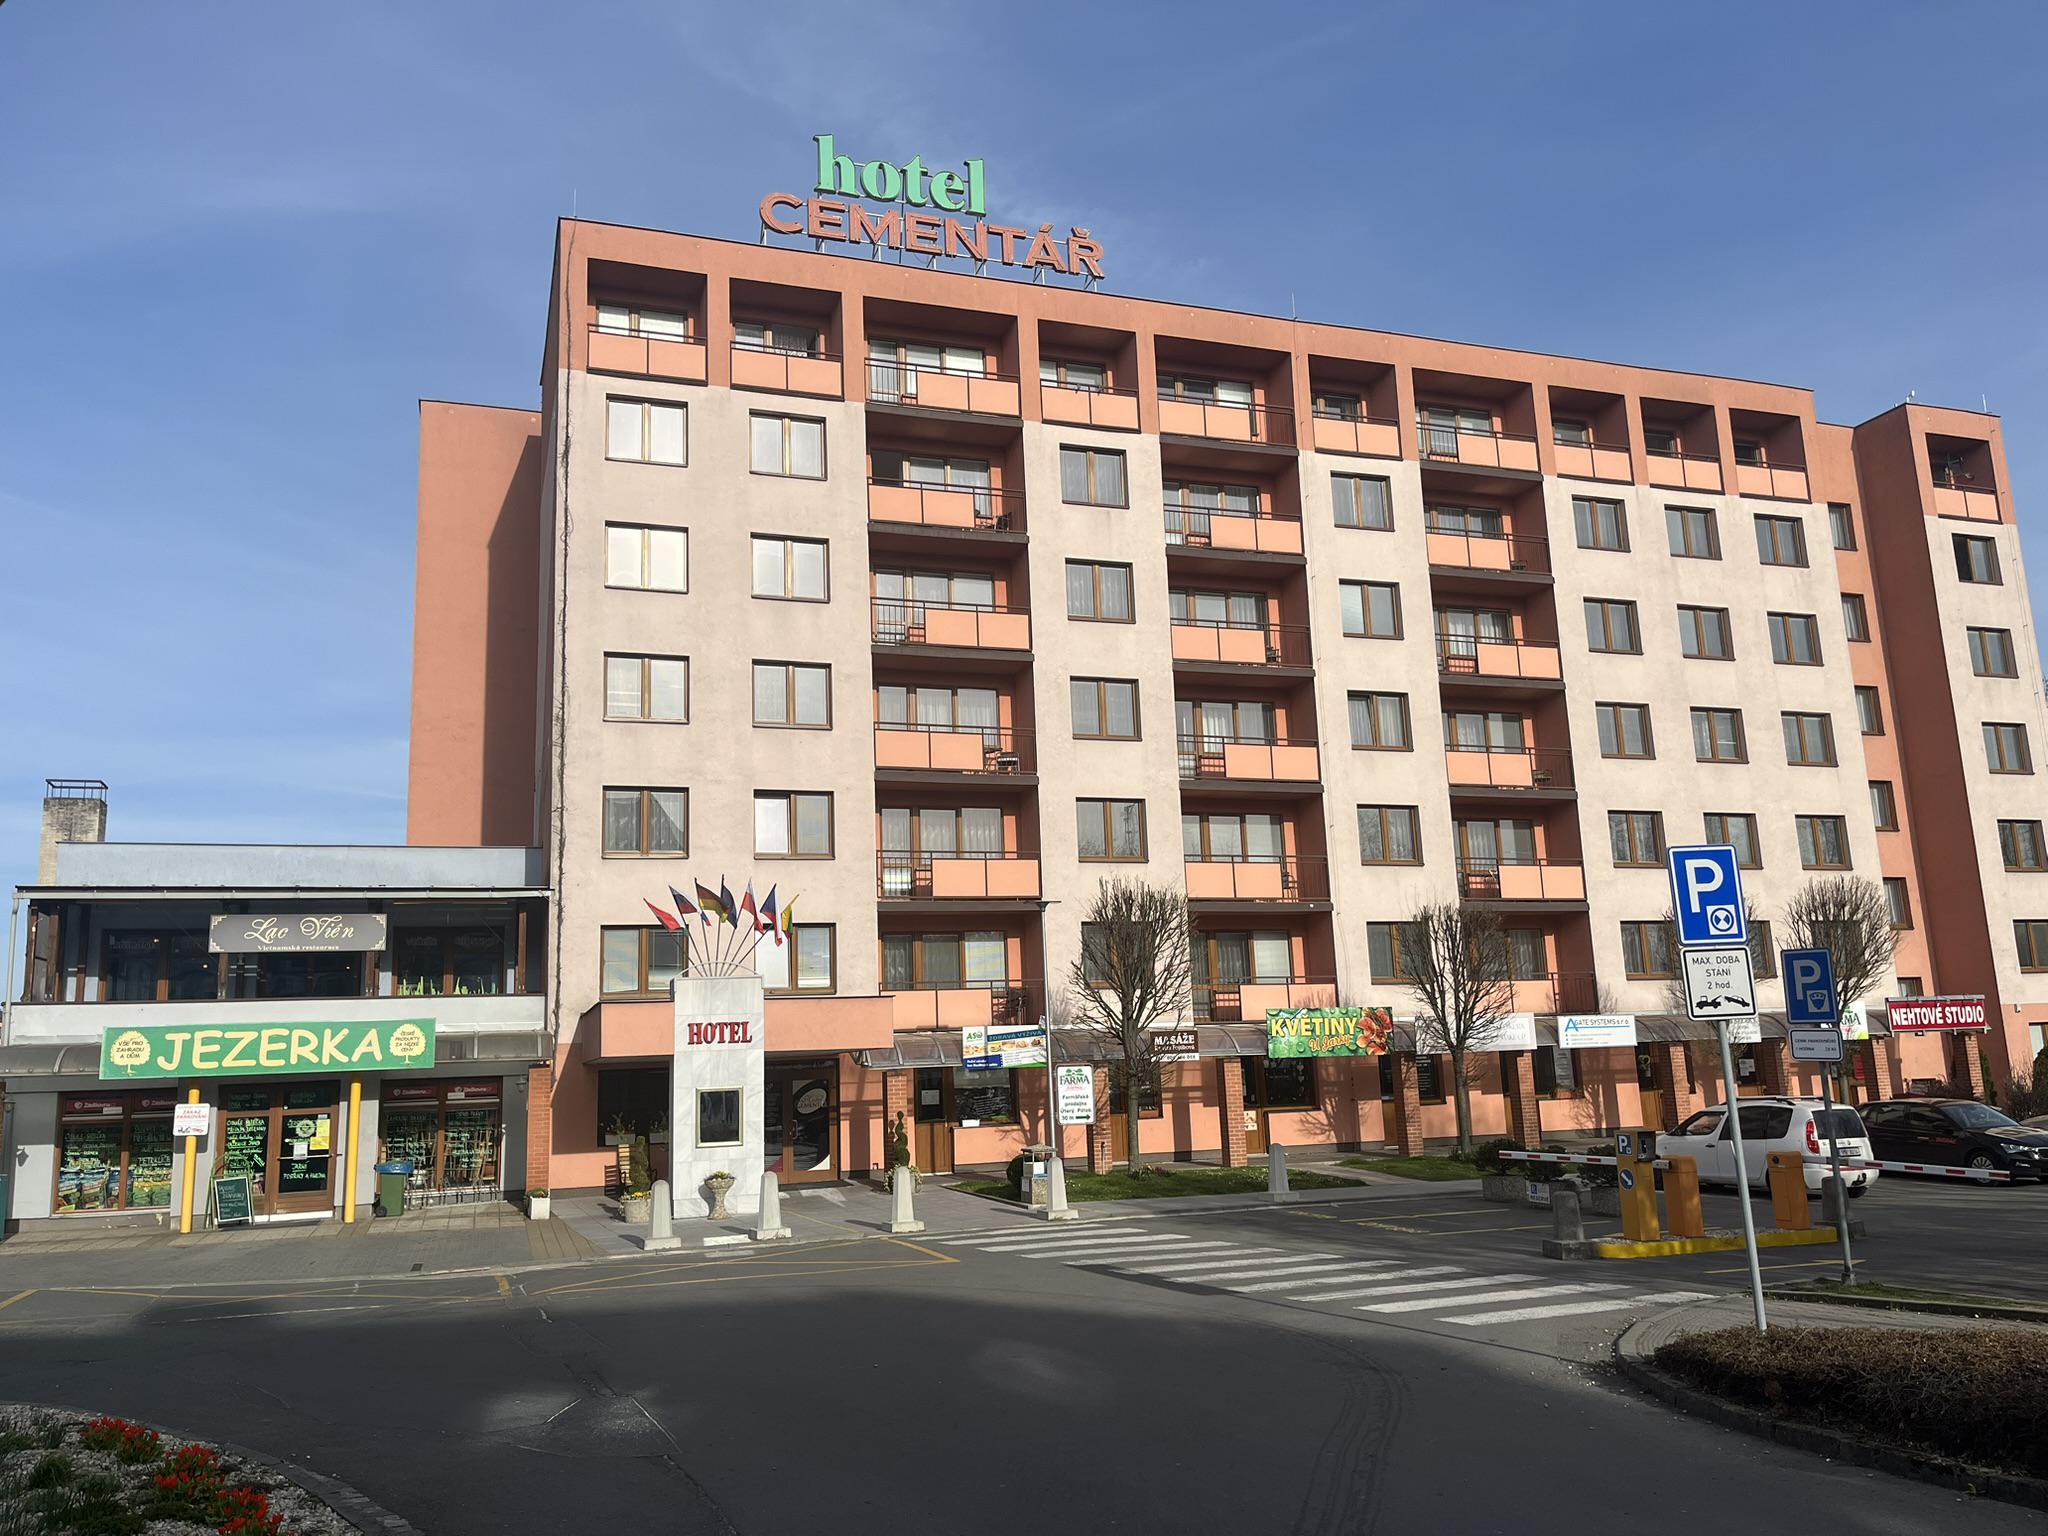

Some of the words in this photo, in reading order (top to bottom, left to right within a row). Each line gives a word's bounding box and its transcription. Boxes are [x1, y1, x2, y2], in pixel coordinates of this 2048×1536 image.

[812, 133, 986, 217] hotel
[759, 192, 1105, 279] CEMENTÁŘ
[1685, 859, 1724, 913] P
[1692, 956, 1714, 966] MAX.
[1716, 955, 1740, 964] DOBA
[1707, 981, 1713, 989] 2
[1715, 980, 1733, 989] hod.
[1792, 959, 1821, 1001] P
[1271, 1014, 1358, 1037] KVĚTINY
[1891, 1003, 1943, 1026] NEHTOVÉ
[1944, 1005, 1984, 1024] STUDIO
[687, 1021, 753, 1045] HOTEL
[1154, 1032, 1195, 1046] MASÁŽE
[156, 1028, 383, 1071] JEZERKA
[1060, 1075, 1090, 1085] FARMA
